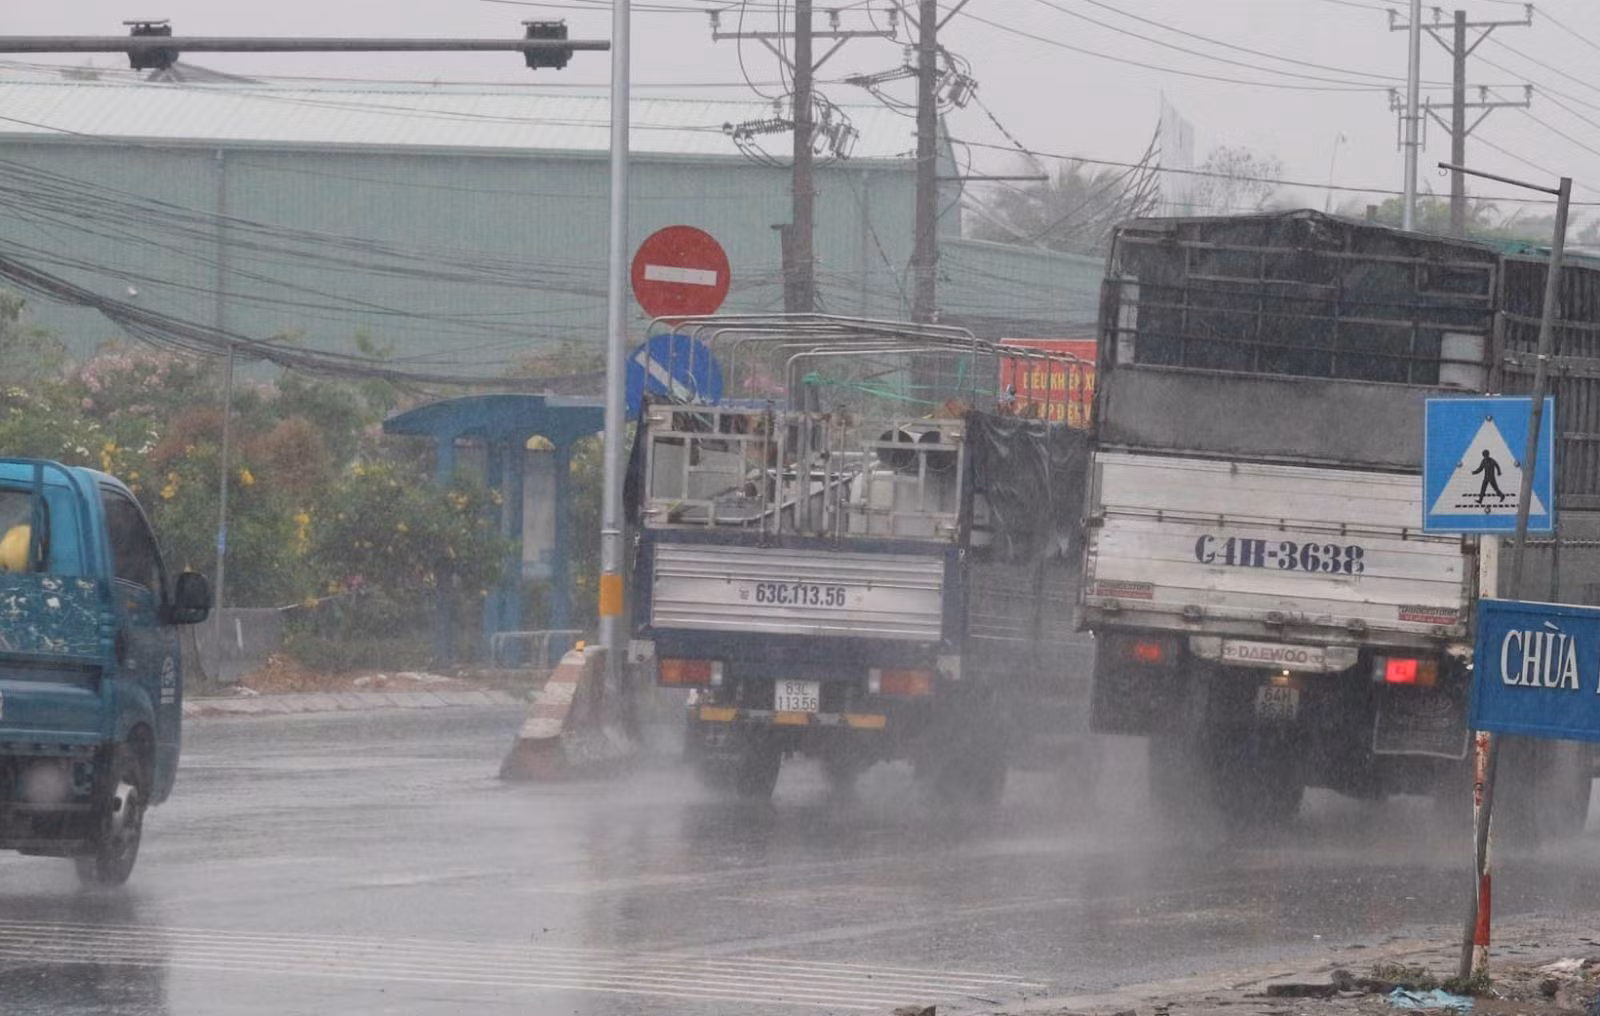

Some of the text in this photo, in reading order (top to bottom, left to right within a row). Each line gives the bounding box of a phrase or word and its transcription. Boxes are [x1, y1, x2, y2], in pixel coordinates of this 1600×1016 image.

[756, 583, 846, 606] 63C.113.56
[1238, 645, 1308, 663] DAEWOO
[1500, 620, 1579, 689] CHÙA
[785, 681, 809, 695] 63C
[1264, 687, 1291, 703] 64H
